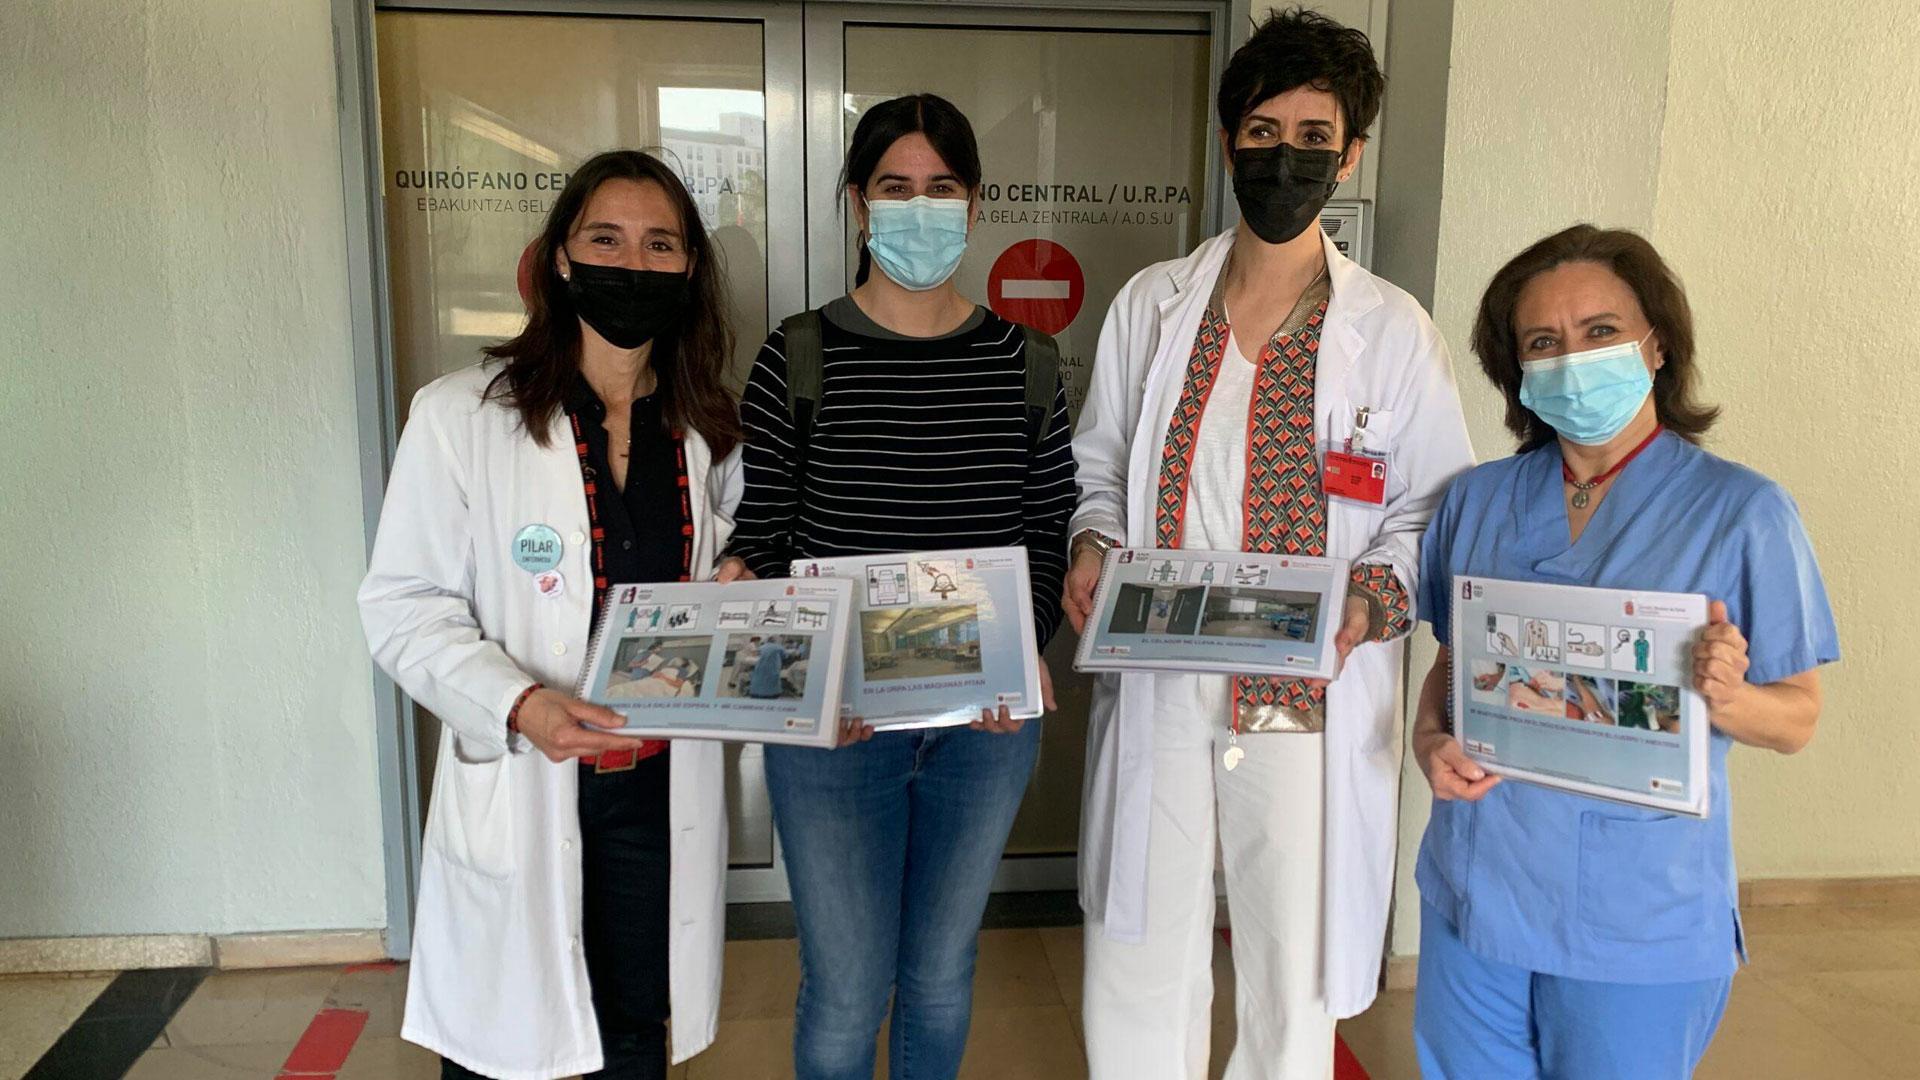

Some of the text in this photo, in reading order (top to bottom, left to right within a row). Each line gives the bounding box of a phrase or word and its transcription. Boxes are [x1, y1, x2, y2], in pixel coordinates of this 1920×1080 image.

[396, 165, 527, 191] QUIRÓFANO
[1007, 184, 1103, 203] CENTRAL
[1108, 184, 1117, 204] /
[1123, 185, 1191, 204] U.R.PA
[417, 198, 514, 212] EBAKUNTZA
[990, 210, 1028, 223] GELA
[1033, 211, 1108, 224] ZENTRALA
[1112, 211, 1118, 226] /
[1122, 212, 1173, 225] A.O.S.U
[521, 539, 553, 553] PILAR
